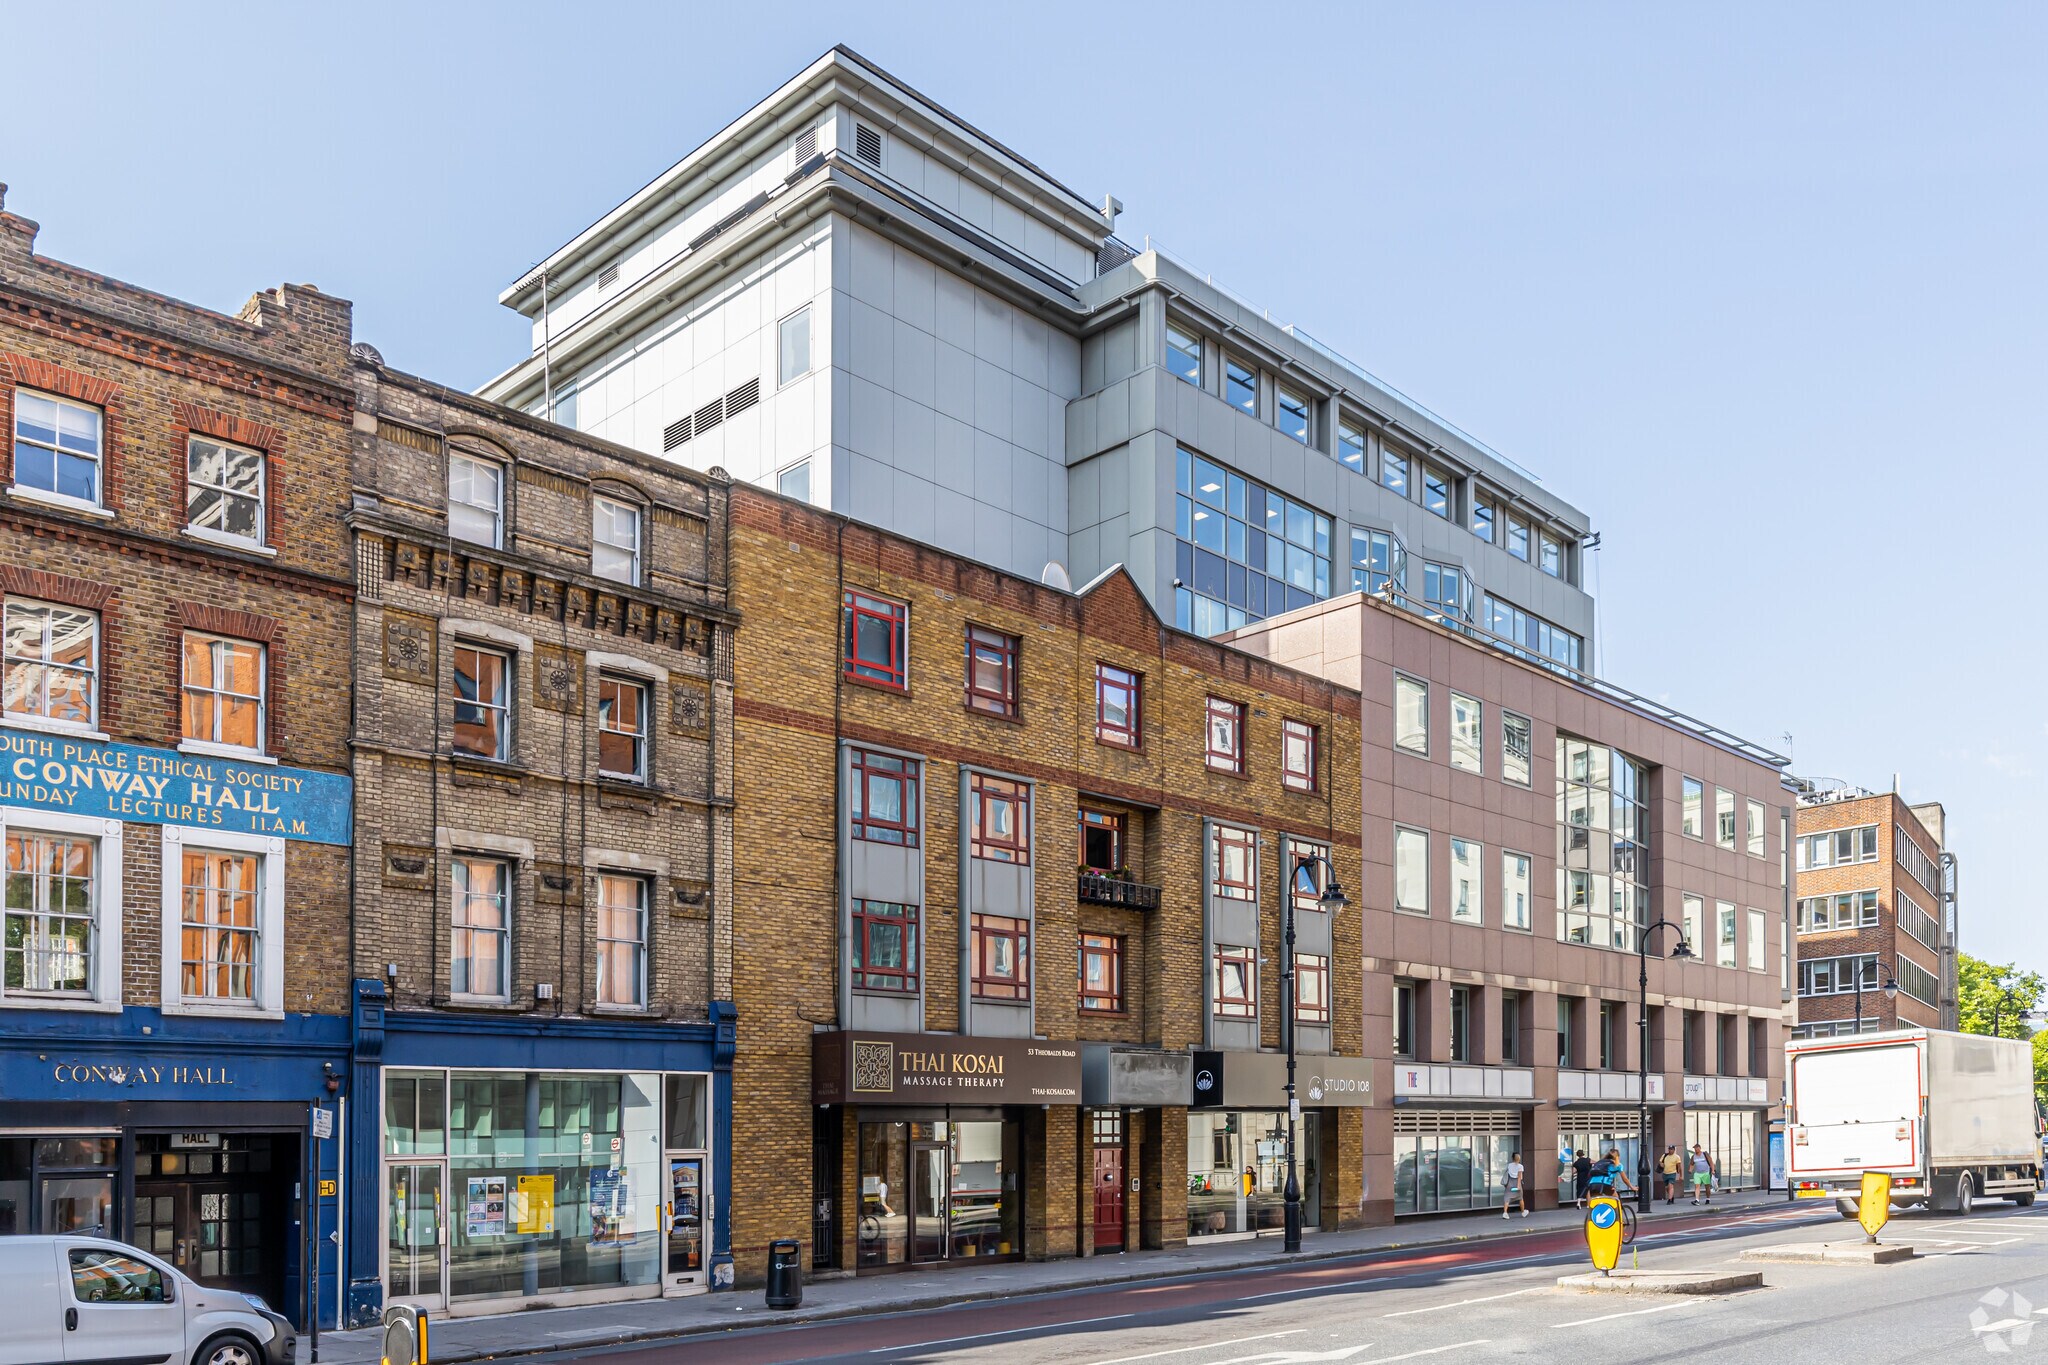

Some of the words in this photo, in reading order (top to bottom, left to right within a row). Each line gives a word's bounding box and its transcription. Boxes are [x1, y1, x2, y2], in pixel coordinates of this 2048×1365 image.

[63, 744, 128, 769] PLACE
[137, 755, 217, 781] ETHICAL
[225, 769, 303, 793] SOCIETY
[13, 757, 170, 799] CONWAY
[190, 782, 280, 814] HALL
[109, 796, 223, 824] LECTURES
[54, 1063, 165, 1084] CONWAY
[173, 1067, 233, 1084] HALL
[899, 1051, 946, 1073] THAI
[951, 1053, 1004, 1074] KOSAI
[903, 1076, 953, 1087] MASSAGE
[957, 1077, 1005, 1088] THERAPY
[1324, 1078, 1355, 1092] STUDIO
[1357, 1081, 1370, 1092] 108
[182, 1133, 210, 1144] HALL
